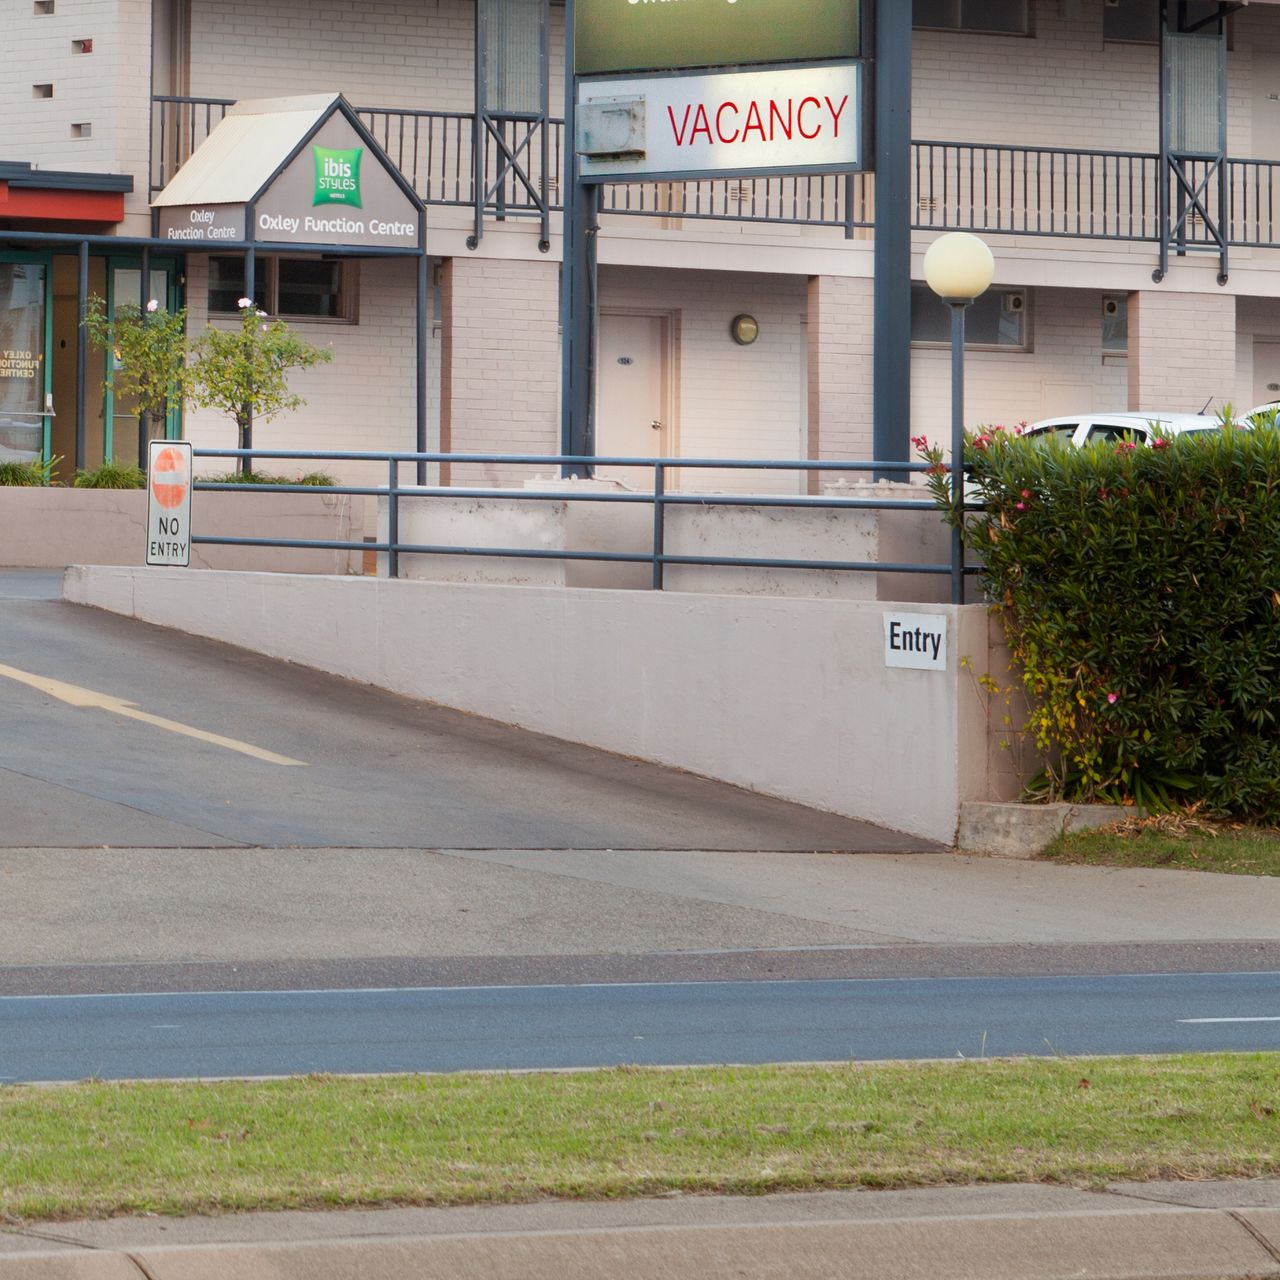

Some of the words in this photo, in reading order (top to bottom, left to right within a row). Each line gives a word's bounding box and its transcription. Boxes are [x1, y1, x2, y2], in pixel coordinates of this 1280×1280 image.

[667, 94, 849, 147] VACANCY
[324, 157, 352, 178] ibis
[190, 209, 215, 225] Oxley
[259, 214, 300, 234] Oxley
[304, 216, 365, 234] Function
[368, 219, 415, 236] Centre
[167, 226, 204, 240] Function
[207, 226, 236, 239] Centre
[158, 516, 180, 536] NO
[150, 541, 187, 557] ENTRY
[889, 621, 942, 661] Entry
